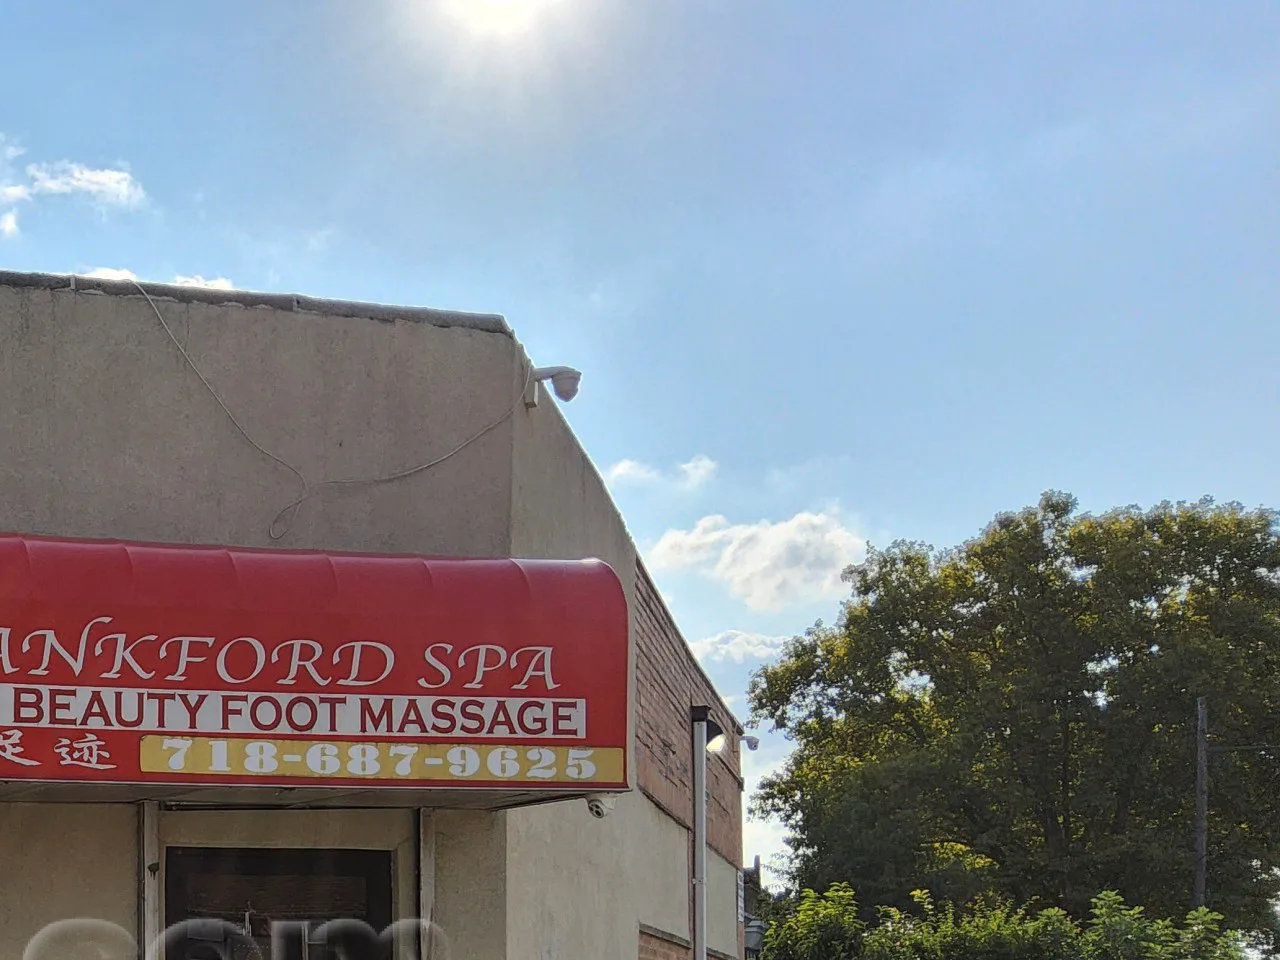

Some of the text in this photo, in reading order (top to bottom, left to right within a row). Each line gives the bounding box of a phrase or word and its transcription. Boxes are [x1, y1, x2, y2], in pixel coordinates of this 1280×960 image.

[416, 642, 561, 691] SPA
[12, 687, 210, 730] BEAUTY
[220, 694, 347, 733] FOOT
[359, 697, 579, 737] MASSAGE
[161, 738, 597, 780] 718-687-9625
